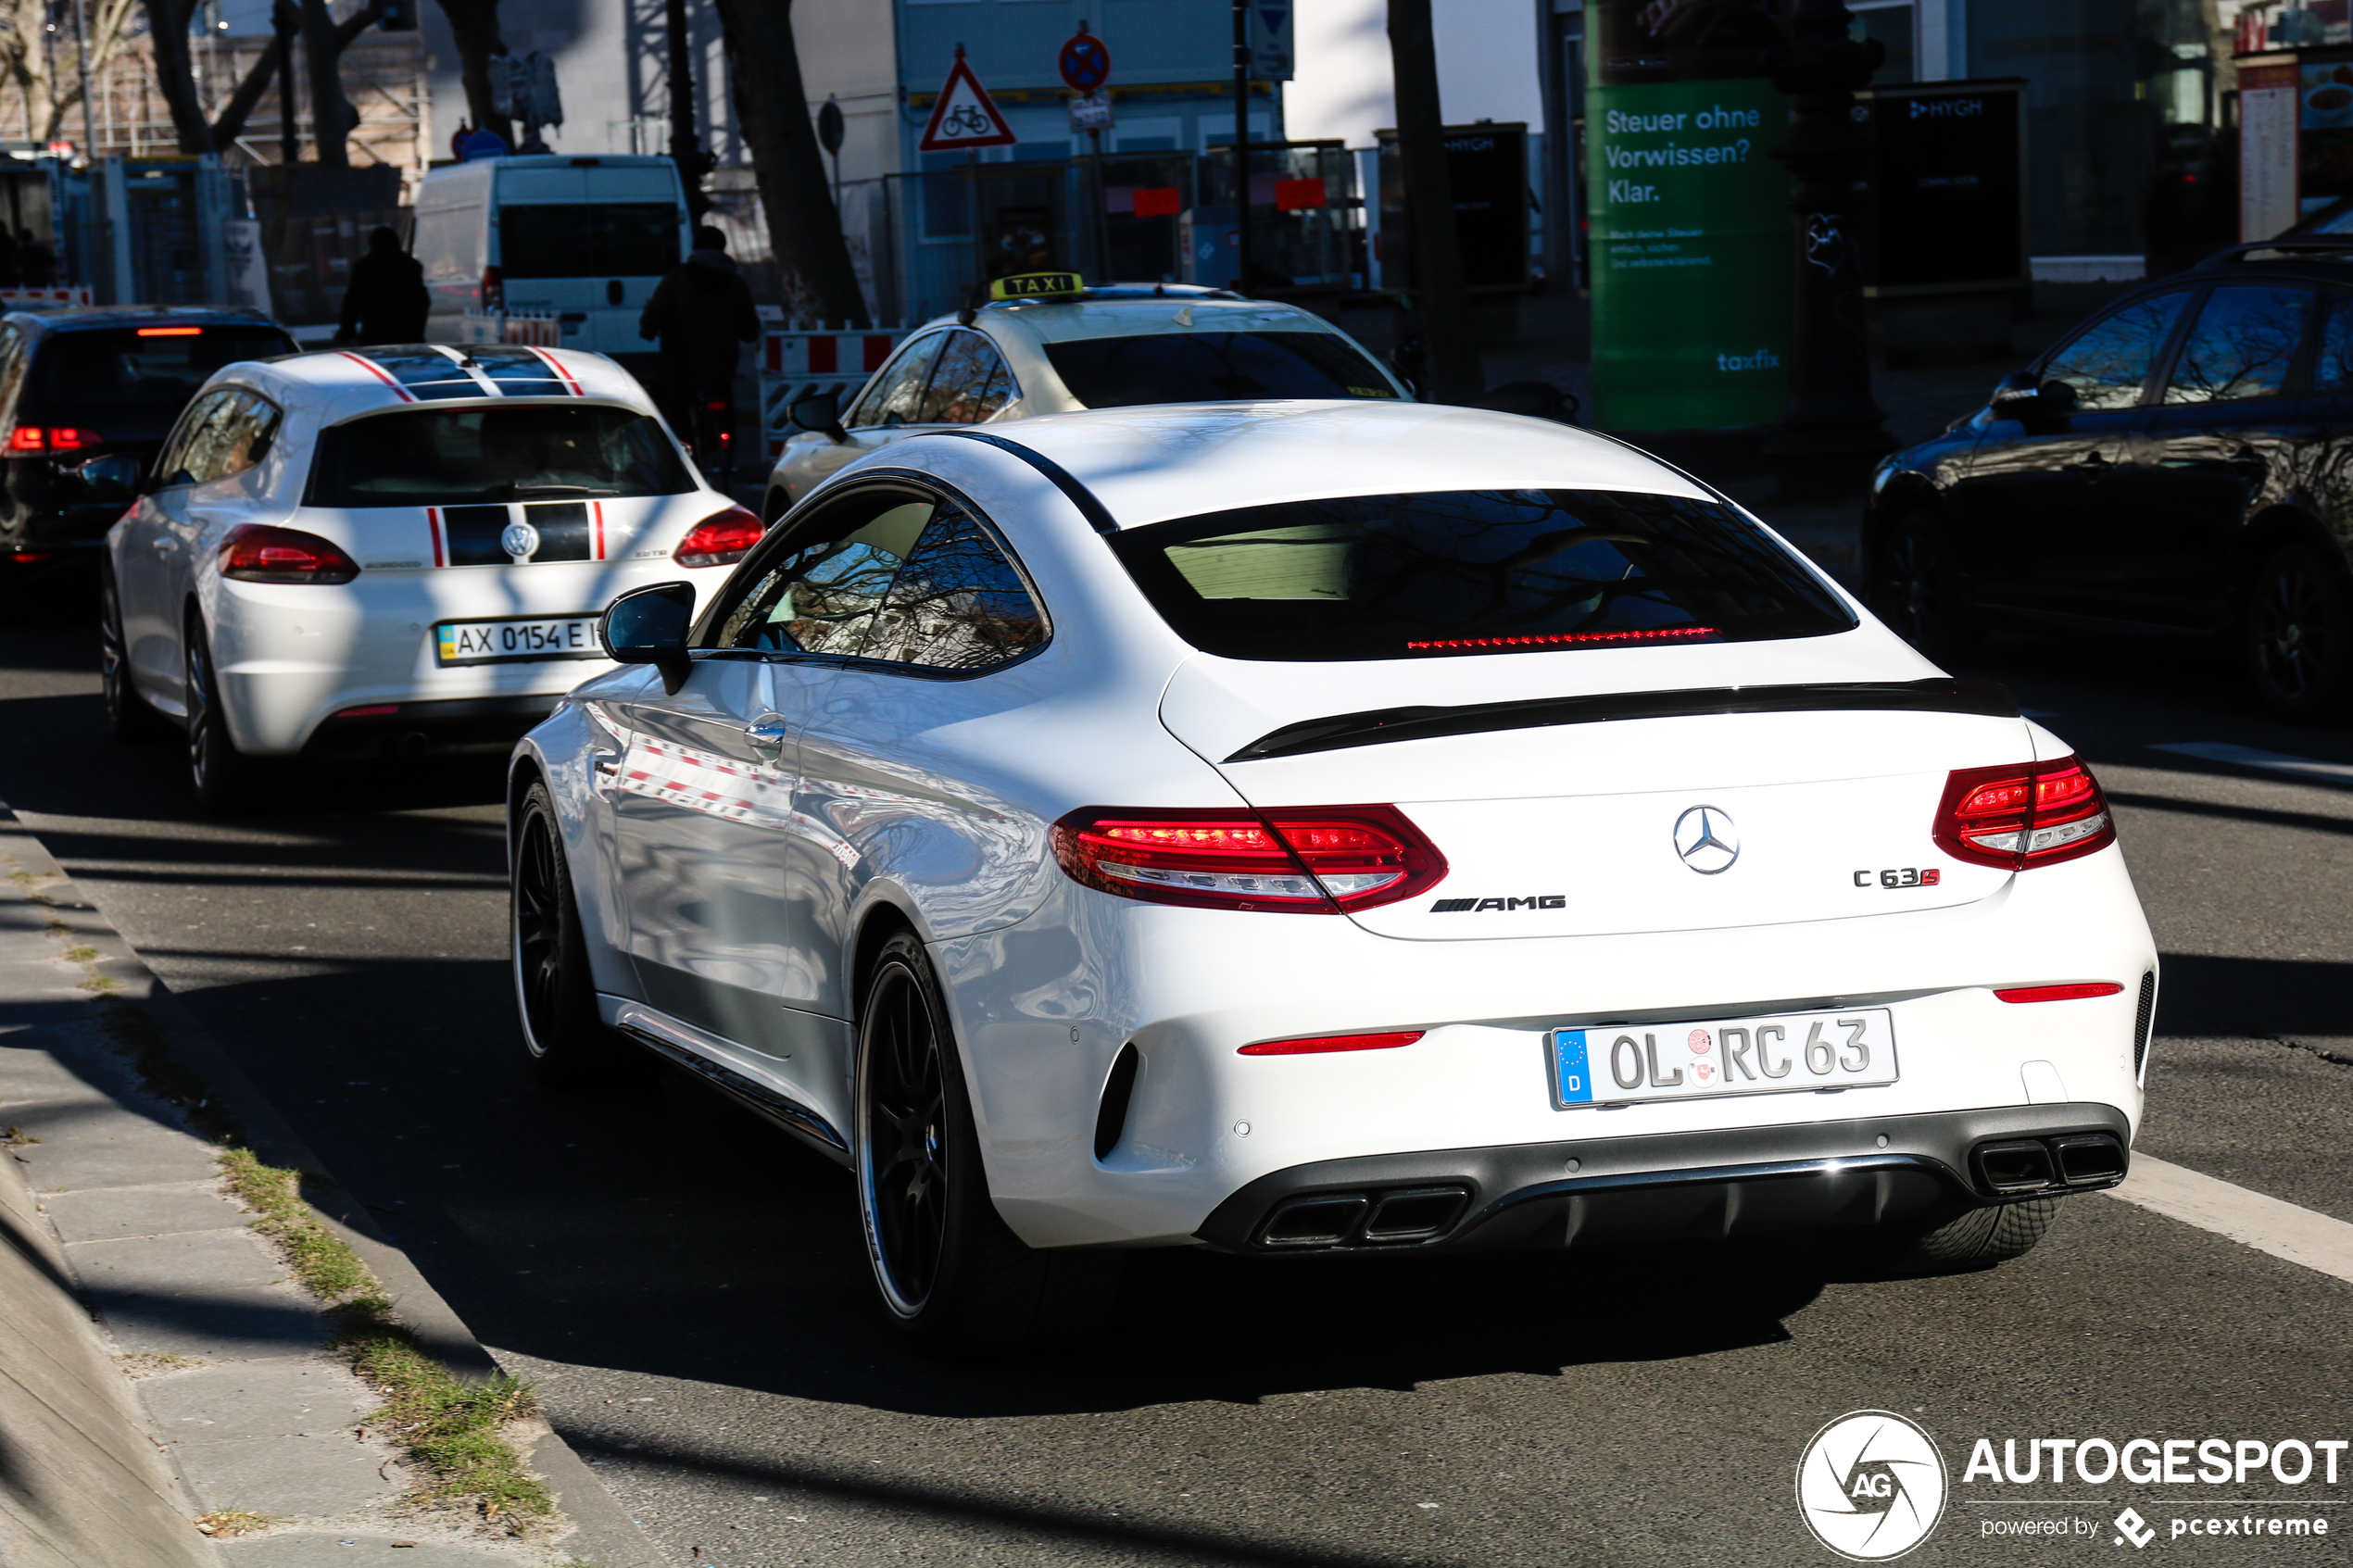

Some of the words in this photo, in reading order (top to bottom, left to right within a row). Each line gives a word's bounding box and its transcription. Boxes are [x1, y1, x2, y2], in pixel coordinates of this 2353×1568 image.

[1606, 109, 1688, 134] Steuer
[1695, 104, 1760, 129] ohne
[1929, 99, 1982, 118] HYGH
[1605, 139, 1751, 169] Vorwissen?
[1608, 180, 1660, 203] Klar.
[1013, 277, 1065, 294] TAXI
[1717, 348, 1780, 371] taxfix
[458, 627, 493, 653] AX
[501, 624, 560, 651] 0154
[1854, 870, 1872, 887] C
[1474, 895, 1567, 912] AMG
[1611, 1032, 1683, 1089] OL
[1718, 1023, 1792, 1082] RC
[1804, 1016, 1870, 1075] 63
[1569, 1075, 1581, 1092] D
